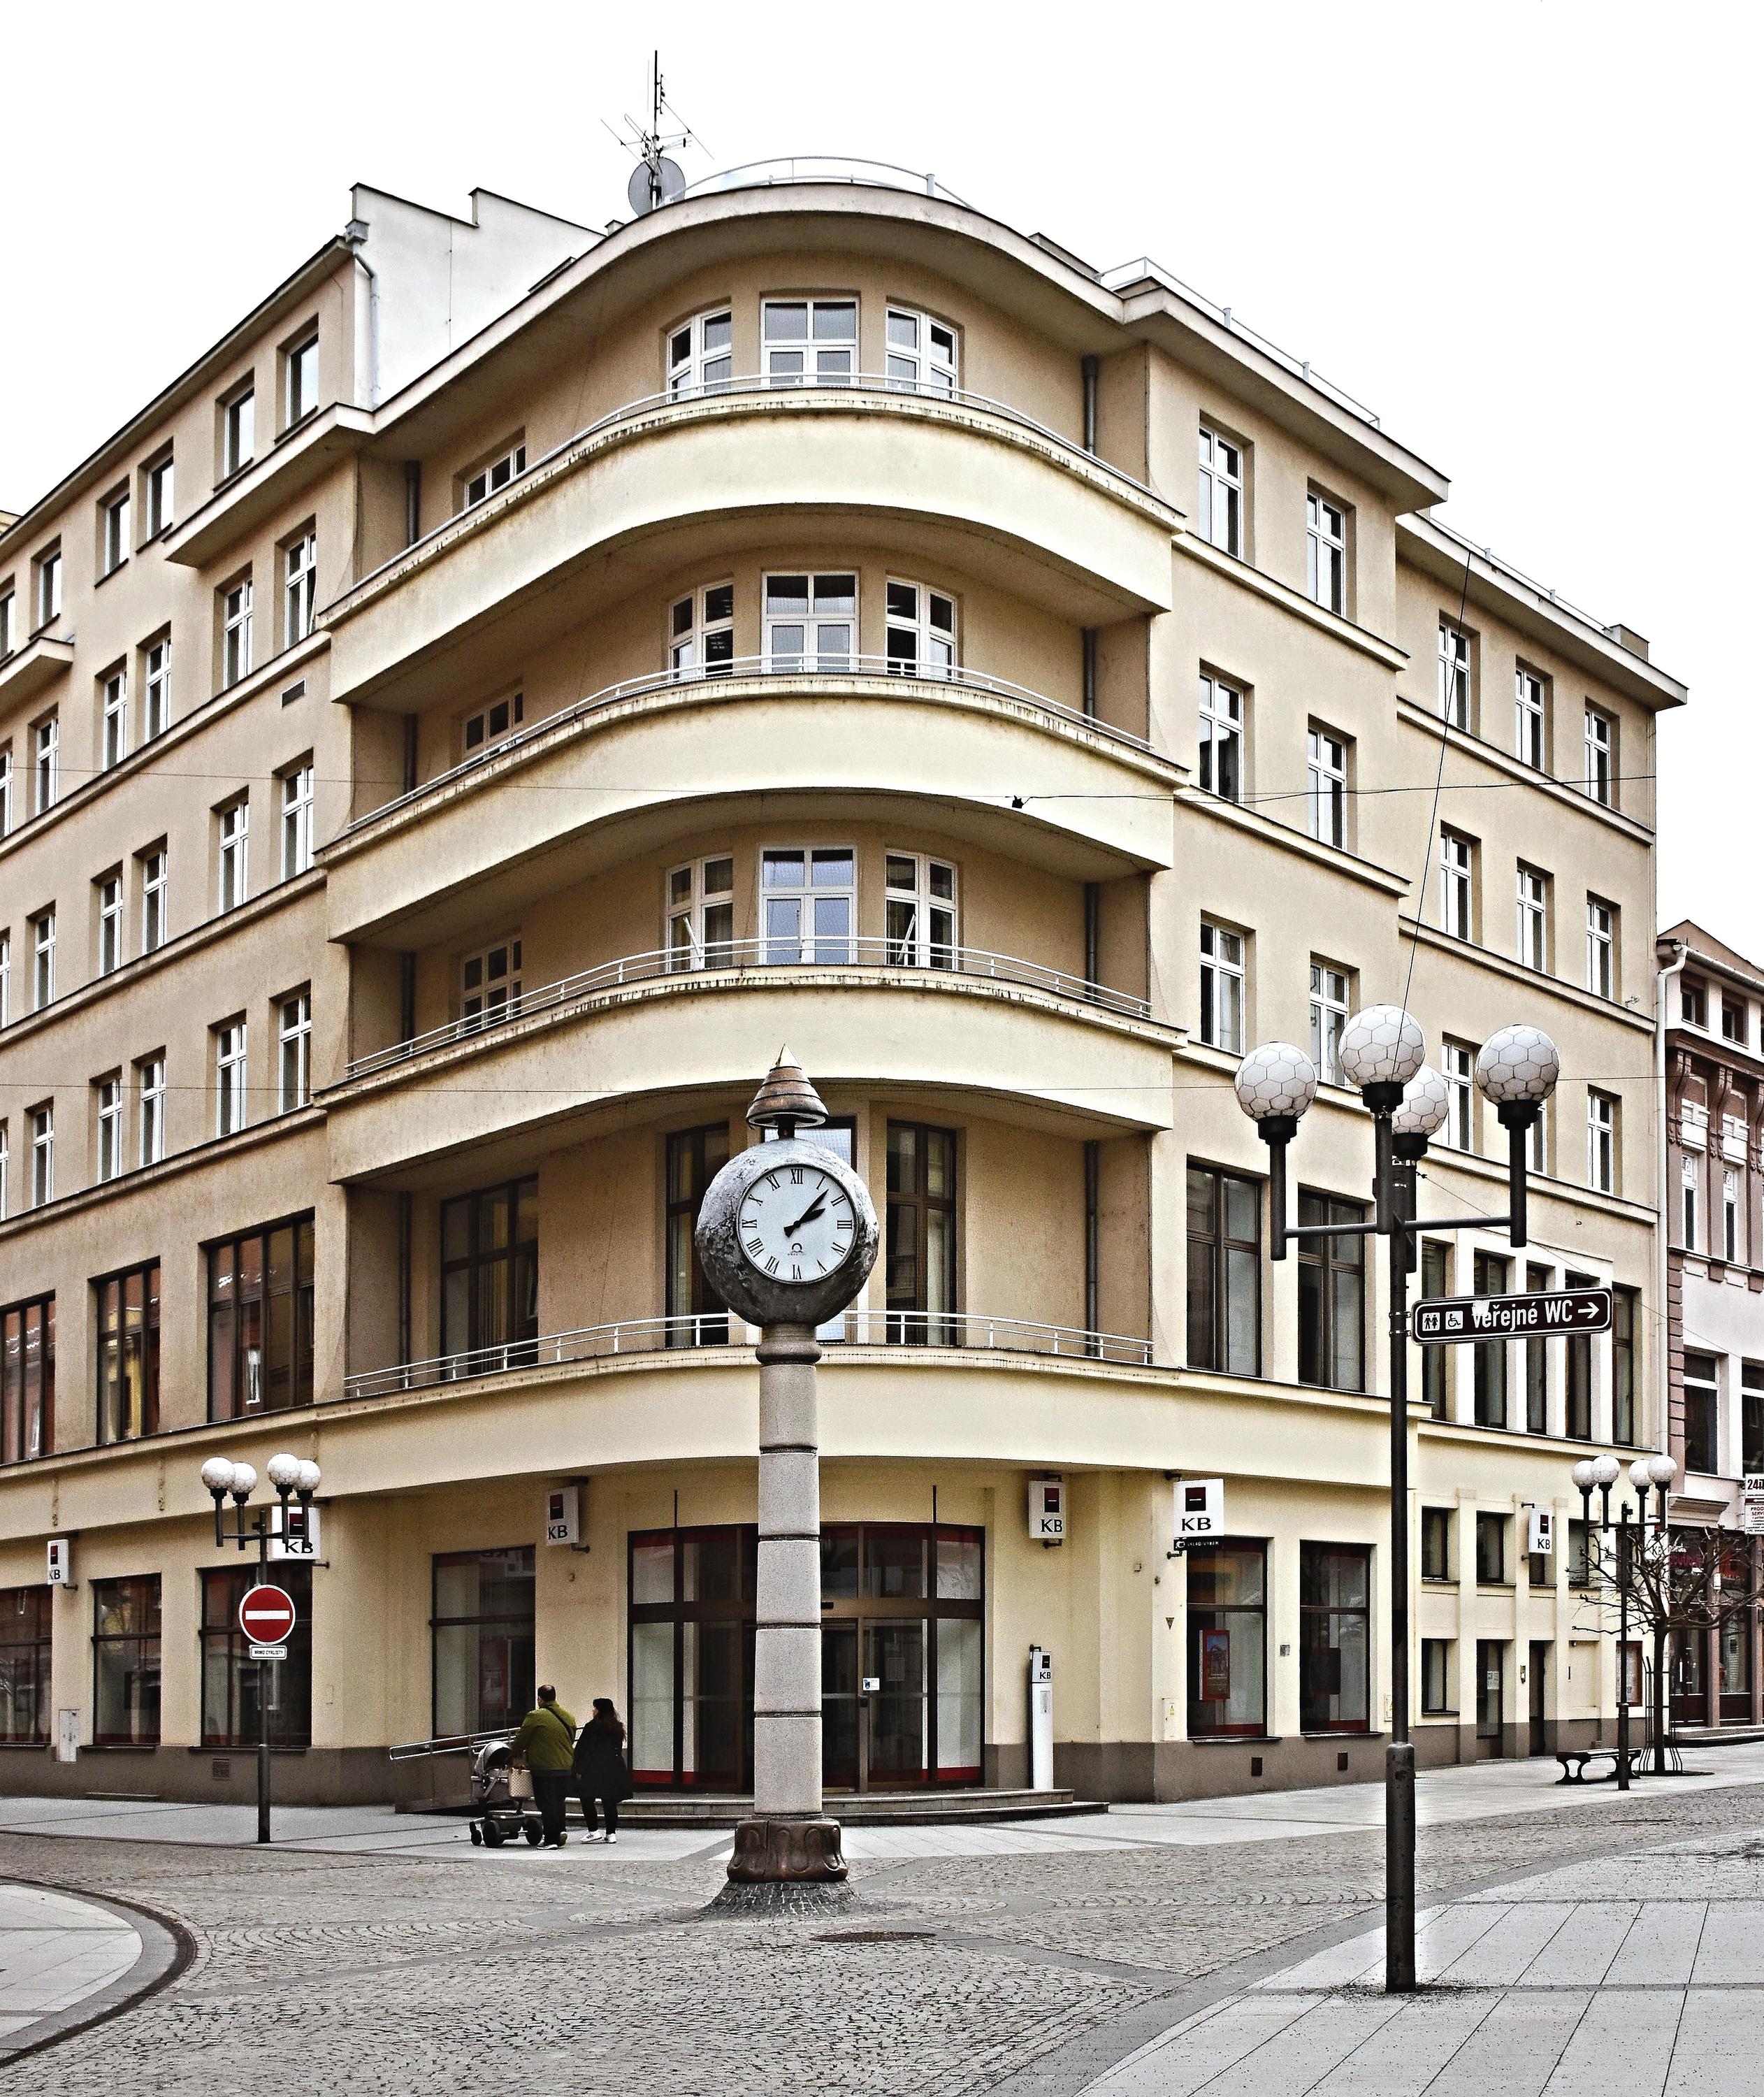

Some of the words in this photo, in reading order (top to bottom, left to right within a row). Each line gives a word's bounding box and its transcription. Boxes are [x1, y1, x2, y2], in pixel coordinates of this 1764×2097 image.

[765, 1174, 781, 1191] XI
[790, 1169, 803, 1184] XII
[816, 1175, 826, 1190] I
[748, 1194, 763, 1206] X
[830, 1194, 846, 1206] II
[742, 1218, 757, 1228] IX
[837, 1219, 853, 1229] III
[746, 1237, 765, 1258] VIII
[830, 1241, 846, 1257] IV
[764, 1255, 780, 1274] VII
[793, 1264, 802, 1279] VI
[816, 1259, 827, 1274] V
[1545, 1299, 1573, 1323] WC
[1041, 1519, 1062, 1532] KB
[1181, 1518, 1211, 1531] KB
[548, 1525, 567, 1540] KB
[285, 1541, 313, 1553] KB
[1538, 1538, 1550, 1549] KB
